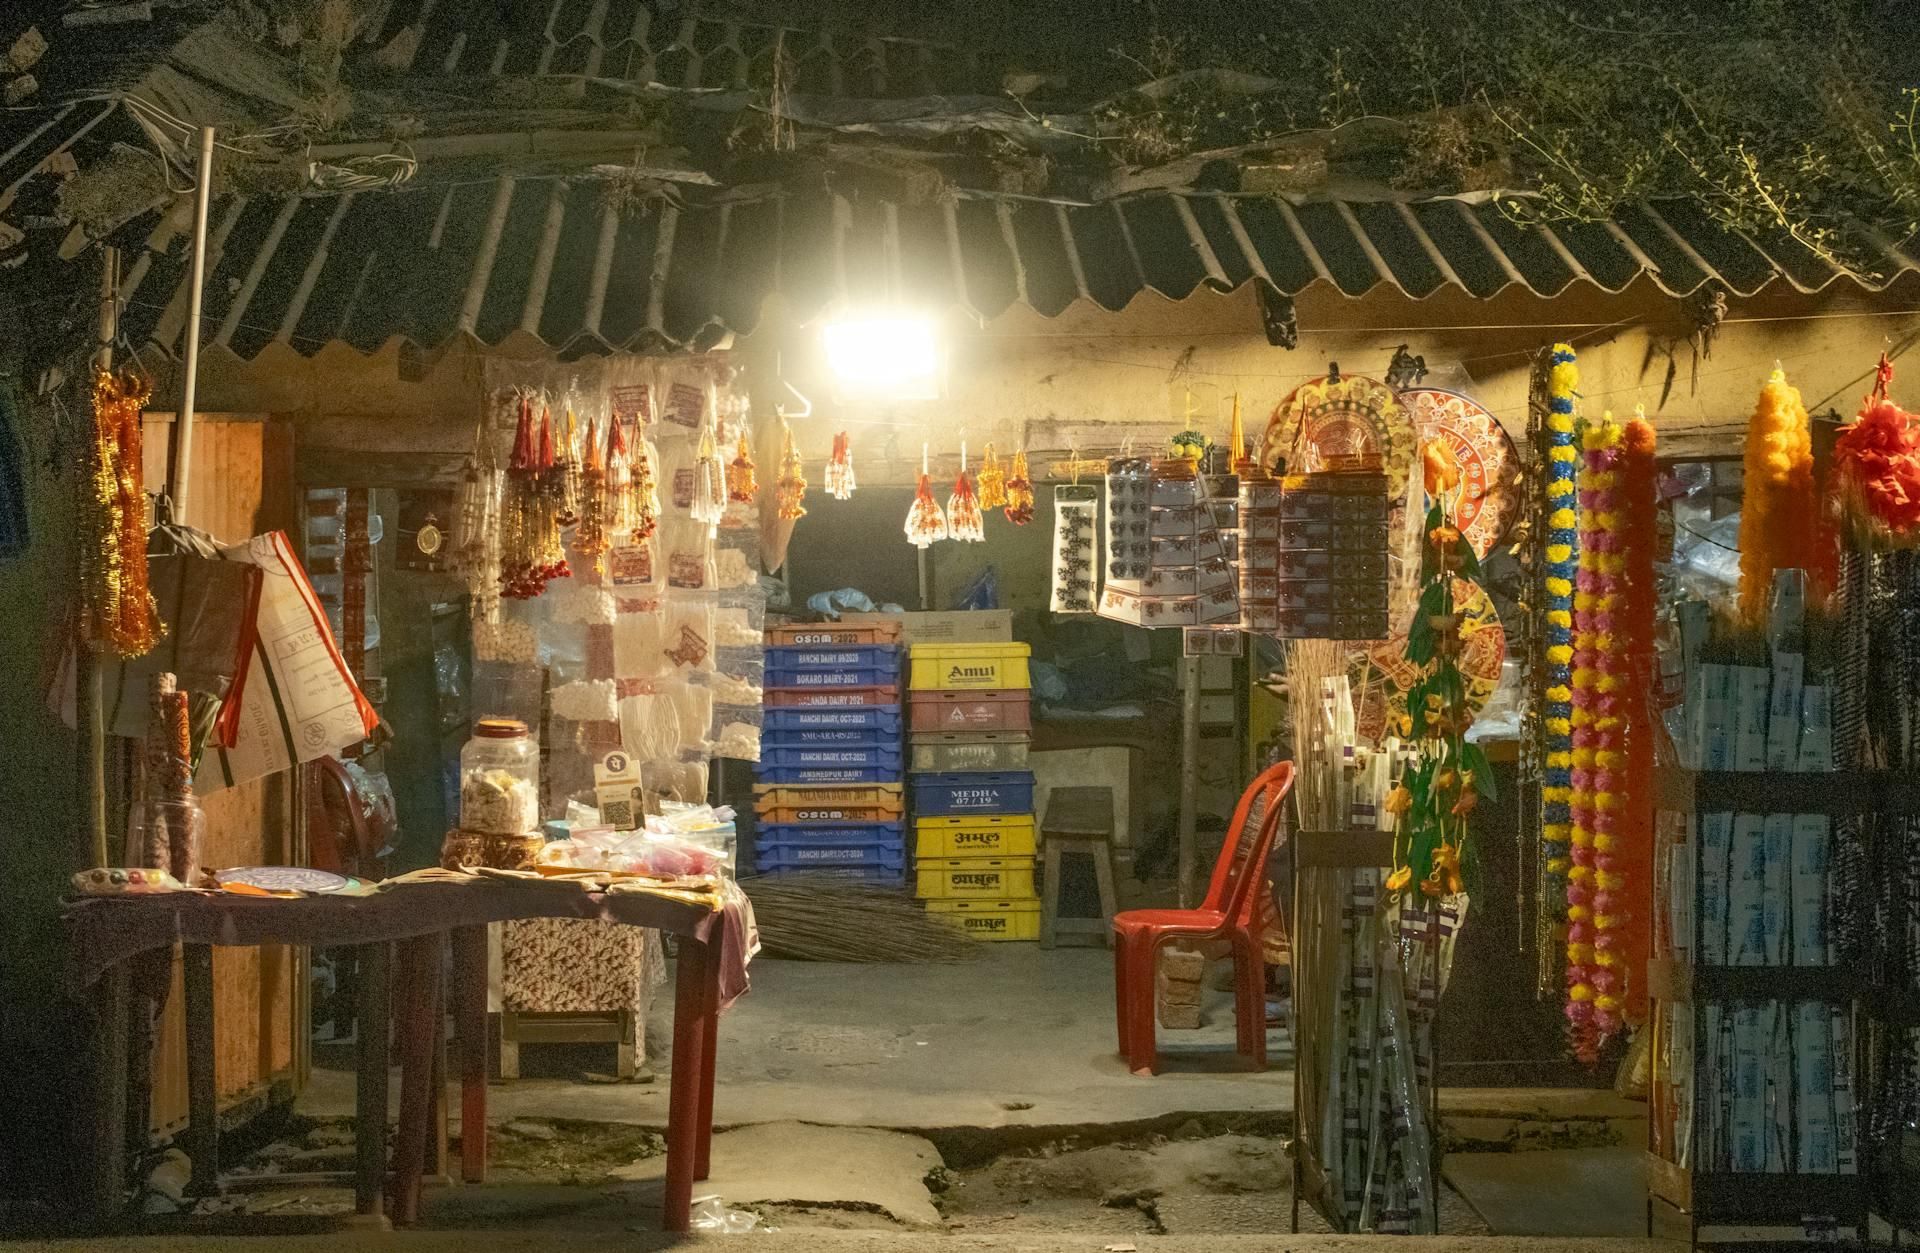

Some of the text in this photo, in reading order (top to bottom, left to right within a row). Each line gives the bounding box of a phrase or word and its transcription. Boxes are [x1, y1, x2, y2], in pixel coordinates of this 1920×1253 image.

[794, 634, 832, 644] osam
[947, 665, 995, 679] Amul
[796, 674, 823, 685] BOKARO
[951, 790, 1000, 798] MEDHA
[797, 810, 844, 819] osam
[954, 832, 1000, 844] अमूल
